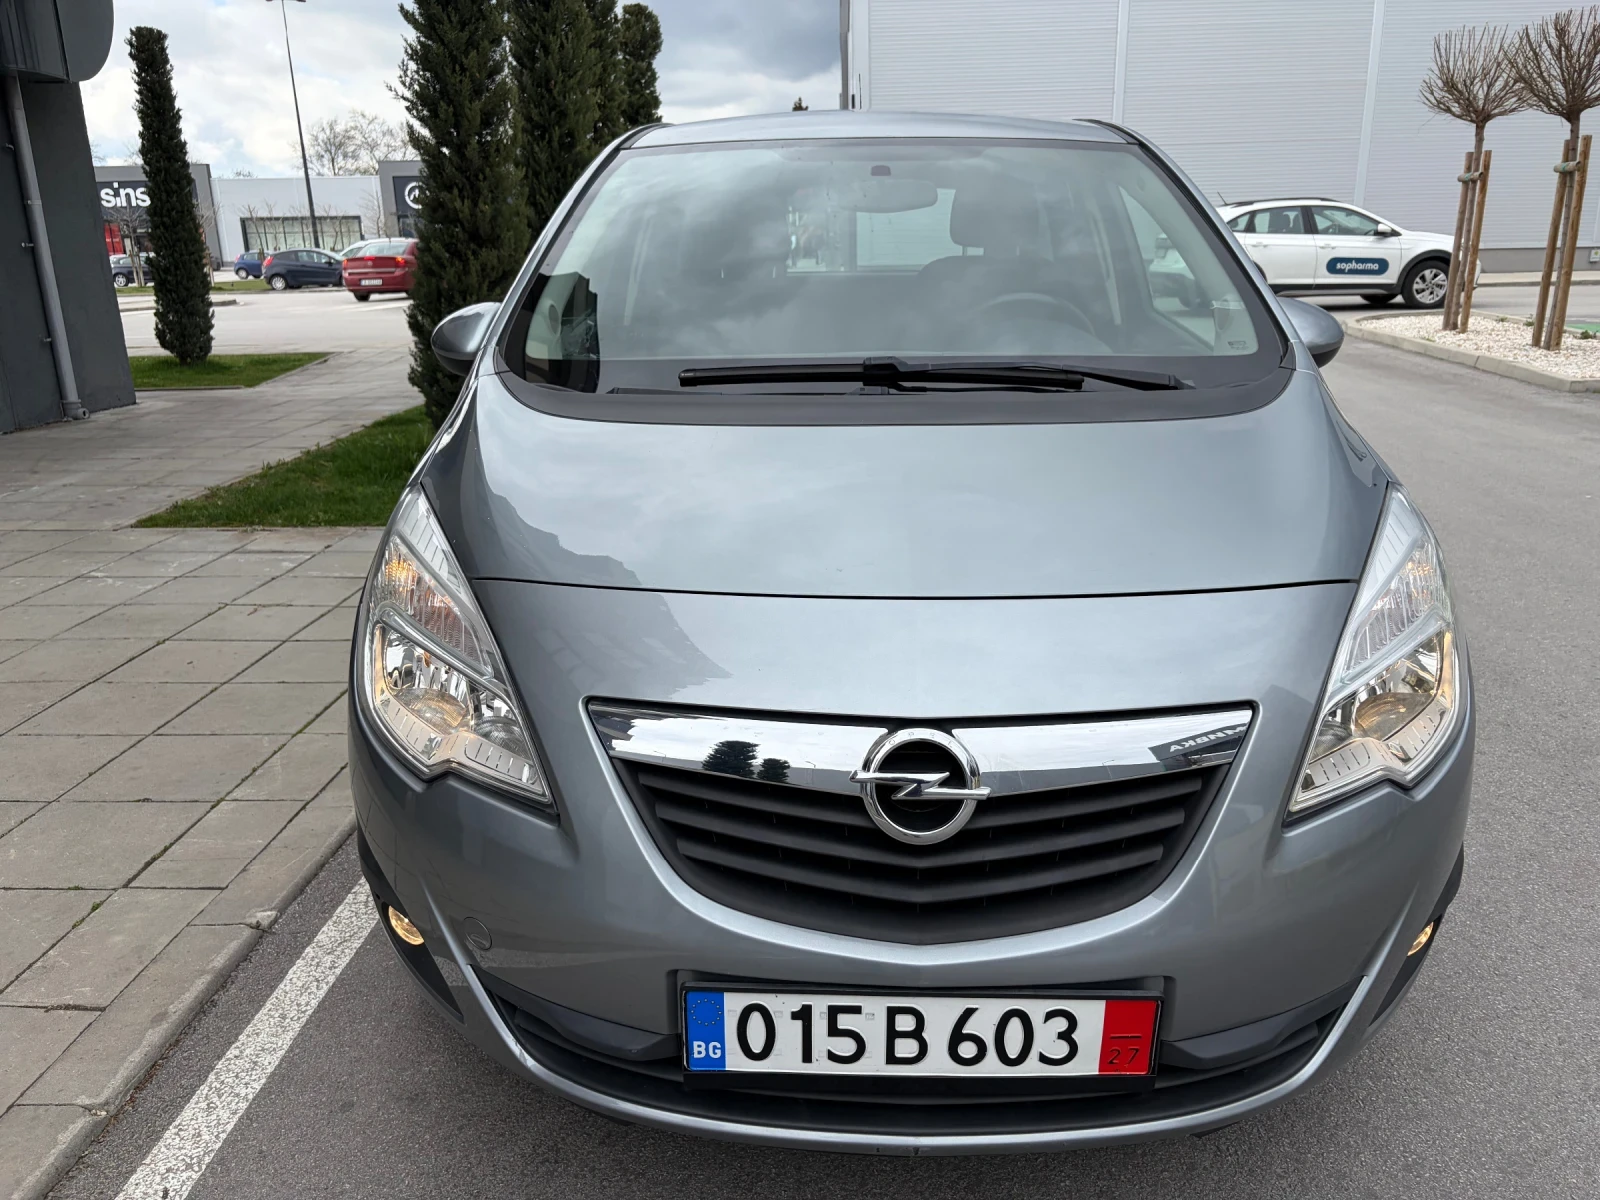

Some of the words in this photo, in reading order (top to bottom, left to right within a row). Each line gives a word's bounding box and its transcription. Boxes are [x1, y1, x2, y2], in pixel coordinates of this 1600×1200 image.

[1336, 260, 1379, 273] sopharma
[693, 1041, 722, 1059] BG
[1107, 1047, 1140, 1067] 27
